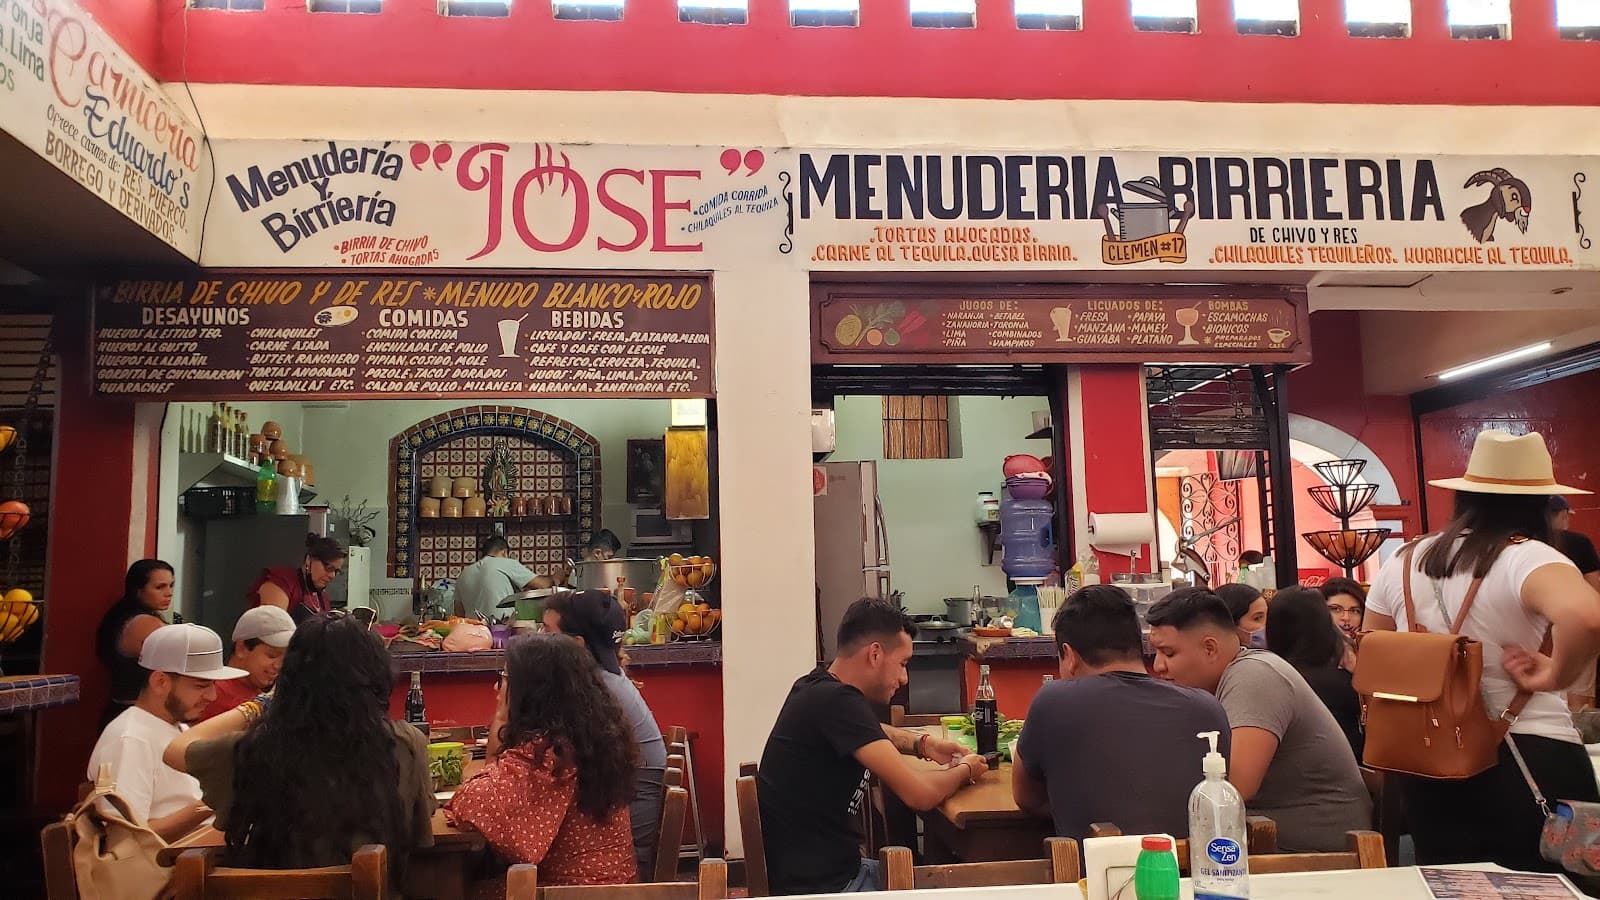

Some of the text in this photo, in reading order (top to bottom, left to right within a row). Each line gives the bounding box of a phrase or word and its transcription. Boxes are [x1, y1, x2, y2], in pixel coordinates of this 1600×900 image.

[81, 135, 107, 164] carnes
[84, 85, 190, 209] Eduardo's
[45, 129, 104, 192] BORREGO
[108, 178, 116, 201] Y
[225, 141, 403, 212] Menudería
[311, 178, 330, 201] Y
[800, 153, 1445, 221] MENUDERIA BIRRIERIA
[699, 185, 768, 215] COMIDA CORRIDA
[688, 206, 732, 232] CHILAQUILES
[735, 204, 744, 214] AL
[1250, 227, 1358, 244] DE CHIVO Y RES
[341, 235, 428, 254] BIRRIA DE CHIVO
[1108, 237, 1184, 261] CLEMEN #17
[351, 249, 439, 266] TORTAS AHOGADAS
[876, 245, 895, 261] AL
[1404, 247, 1484, 263] HUARACHE
[1487, 247, 1506, 264] AL
[189, 280, 223, 305] DE
[309, 281, 332, 304] Y
[332, 280, 369, 306] DE
[370, 280, 423, 306] RES
[435, 281, 539, 308] MENUDO
[543, 282, 634, 309] BLANCO
[637, 283, 702, 310] ROJO
[960, 300, 1018, 311] JUGOS DE:
[1087, 300, 1163, 311] LICUADOS DE:
[1208, 300, 1249, 311] BOMBAS
[142, 307, 250, 326] DESAYUNOS
[379, 309, 469, 328] COMIDAS
[551, 310, 624, 329] BEBIDAS
[947, 312, 984, 320] NARANJA
[1080, 312, 1109, 321] FRESA
[1132, 312, 1166, 322] PAPAYA
[1207, 312, 1269, 322] ESCAMOCHAS
[945, 320, 990, 329] ZANAHORIA
[993, 321, 1029, 329] TORONJA
[1078, 323, 1126, 333] MANZANA
[1131, 323, 1169, 333] MAMEY
[1205, 324, 1250, 334] BIONICOS
[144, 328, 160, 339] AL
[160, 328, 197, 339] ESTILO
[250, 328, 323, 339] CHILAQUILES
[366, 328, 458, 340] COMIDA CORRIDA
[679, 333, 710, 344] MELON
[945, 330, 967, 338] LIMA
[992, 330, 1043, 338] COMBINADOS
[1077, 334, 1120, 344] GUAYABA
[945, 338, 967, 347] PIÑA
[992, 339, 1035, 347] VAMPIROS
[1131, 334, 1173, 345] PLATANO
[142, 342, 158, 353] AL
[158, 342, 198, 353] GUSTO
[249, 340, 330, 351] CARNE ASADA
[366, 341, 489, 354] ENCHILADAS DE POLLO
[529, 343, 667, 356] CAFE Y CAFE CON LECHE
[144, 355, 160, 366] AL
[160, 352, 208, 366] ALBAÑIL
[250, 353, 360, 364] BISTEK RANCHERO
[454, 355, 489, 366] MOLE
[147, 369, 167, 379] DE
[165, 368, 245, 380] CHICHARRON
[249, 366, 356, 378] TORTAS AHOGADAS
[414, 367, 451, 379] TACOS
[98, 382, 175, 393] HUARACHES
[248, 380, 355, 392] QUESADILLAS ETC.
[365, 380, 403, 392] CALDO
[403, 381, 420, 392] DE
[463, 381, 523, 392] MILANESA
[666, 382, 691, 393] ETC.
[1210, 842, 1236, 854] Sensa
[1221, 852, 1237, 862] Zen
